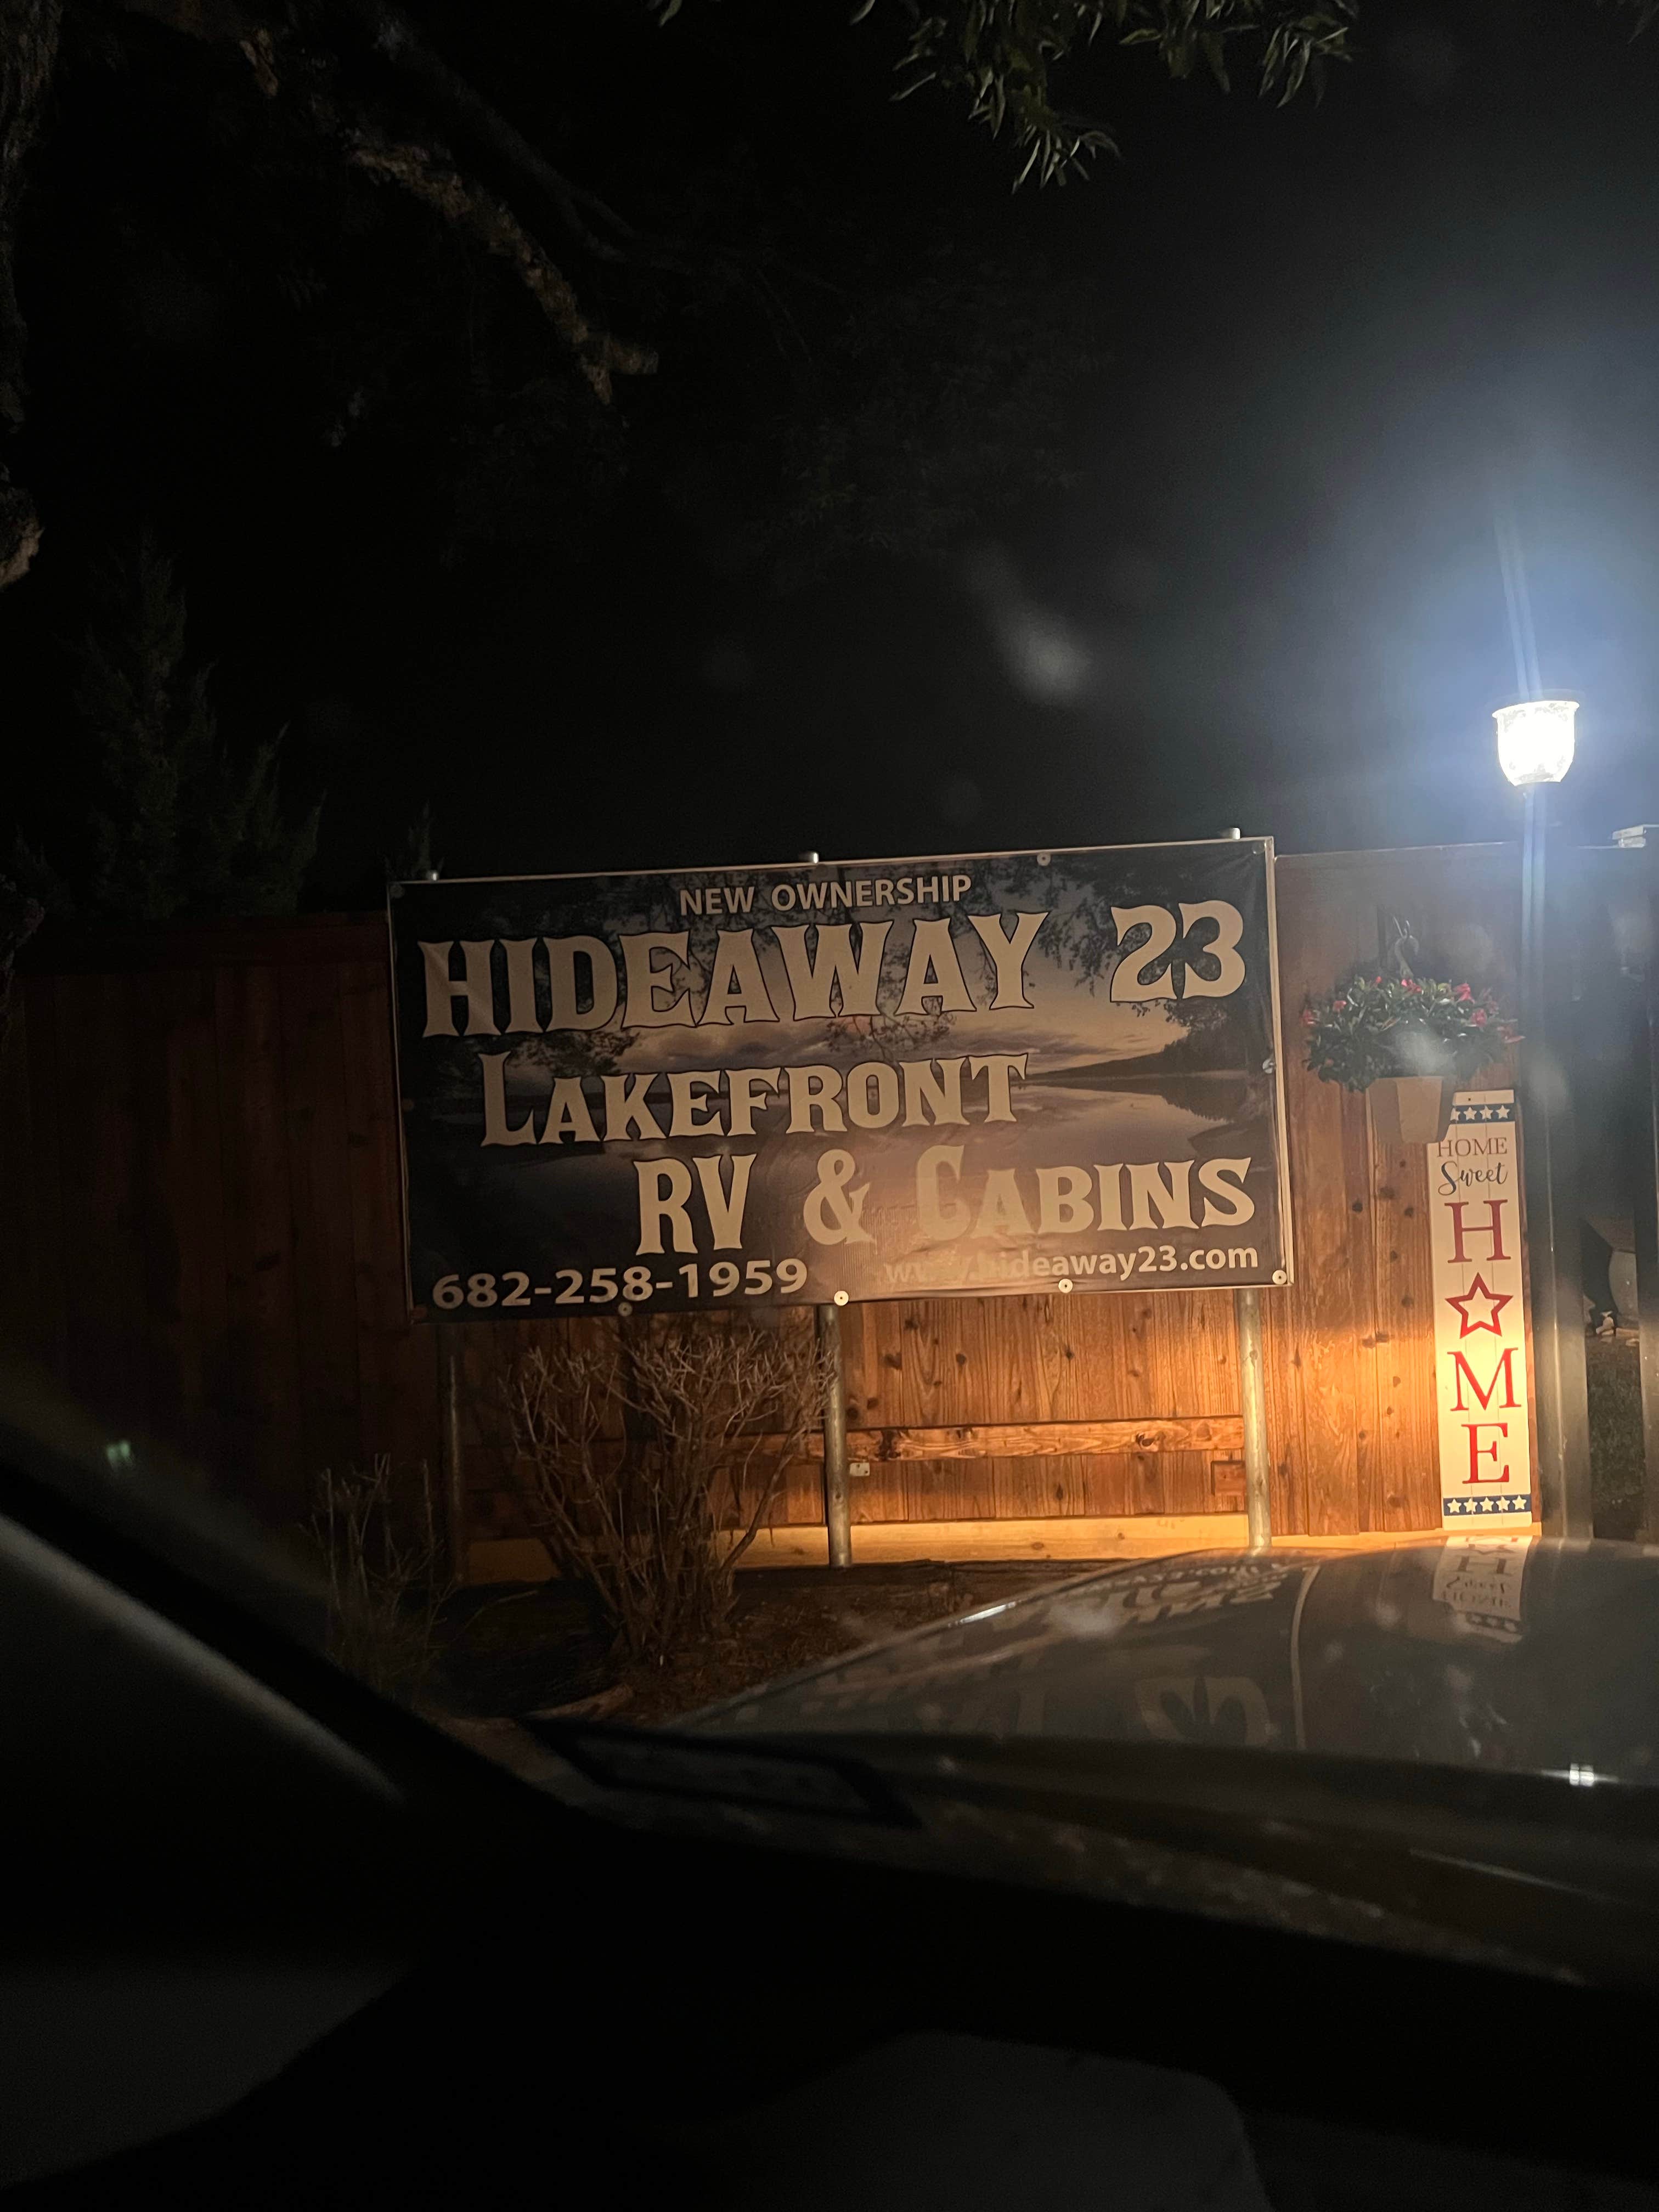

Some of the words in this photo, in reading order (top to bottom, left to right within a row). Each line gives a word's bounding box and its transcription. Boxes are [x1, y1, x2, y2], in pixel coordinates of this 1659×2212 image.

[680, 885, 755, 916] NEW
[771, 874, 973, 912] OWNERSHIP
[416, 911, 1050, 1039] HIDEAWAY
[1110, 900, 1246, 1003] 23
[477, 1053, 1029, 1148] LAKEFRONT
[1437, 1137, 1508, 1158] HOME
[633, 1153, 757, 1256] RV
[803, 1148, 877, 1245] &
[916, 1144, 1256, 1242] CABINS
[1438, 1161, 1508, 1196] Sweet
[431, 1258, 808, 1310] 682-258-1959
[884, 1245, 1258, 1286] w.hideaway23.com
